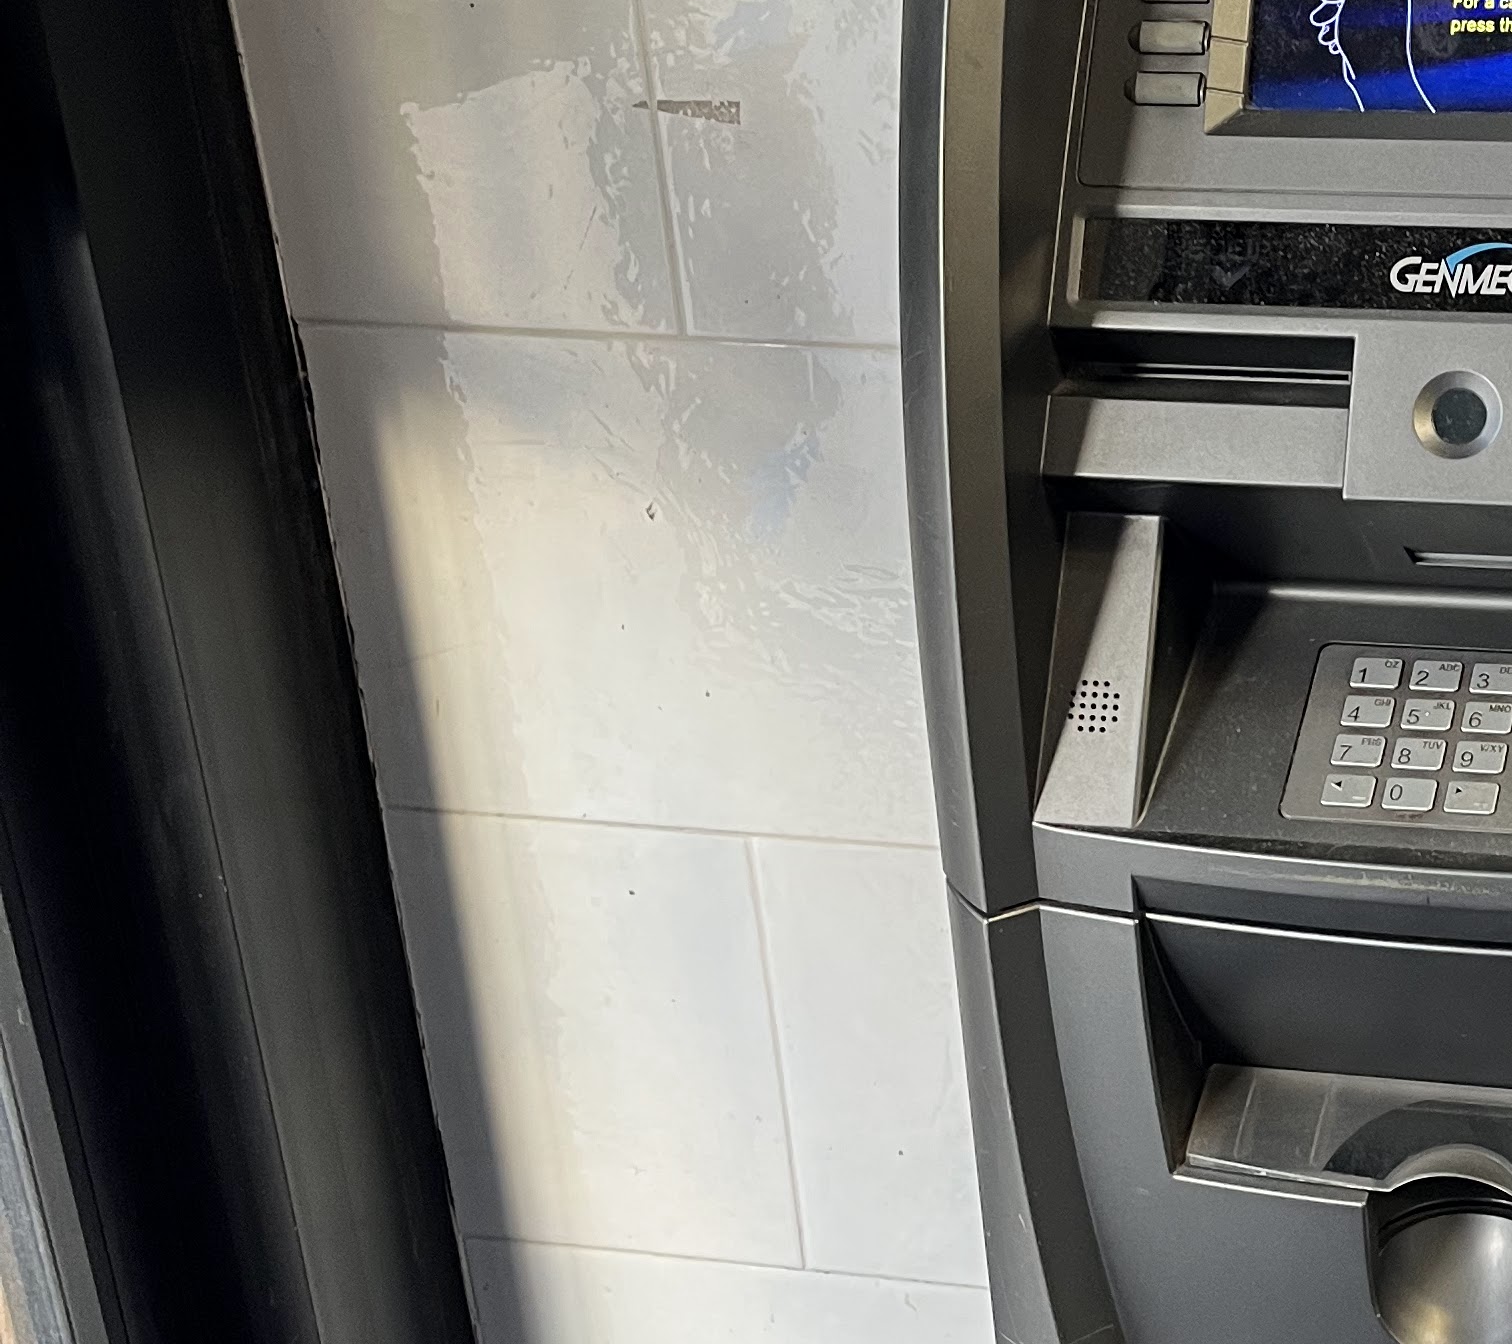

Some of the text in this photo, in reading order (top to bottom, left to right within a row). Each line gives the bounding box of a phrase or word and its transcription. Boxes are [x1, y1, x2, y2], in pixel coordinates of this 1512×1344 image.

[1450, 19, 1495, 36] press
[1358, 667, 1368, 684] 1
[1415, 670, 1430, 686] 2
[1476, 673, 1490, 689] 3
[1347, 706, 1361, 722] 4
[1406, 709, 1421, 725] 5
[1469, 704, 1512, 728] 6 MNO
[1339, 744, 1352, 761] 7
[1397, 741, 1444, 764] 8 TUV
[1460, 751, 1474, 768] 9
[1389, 784, 1403, 801] 0
